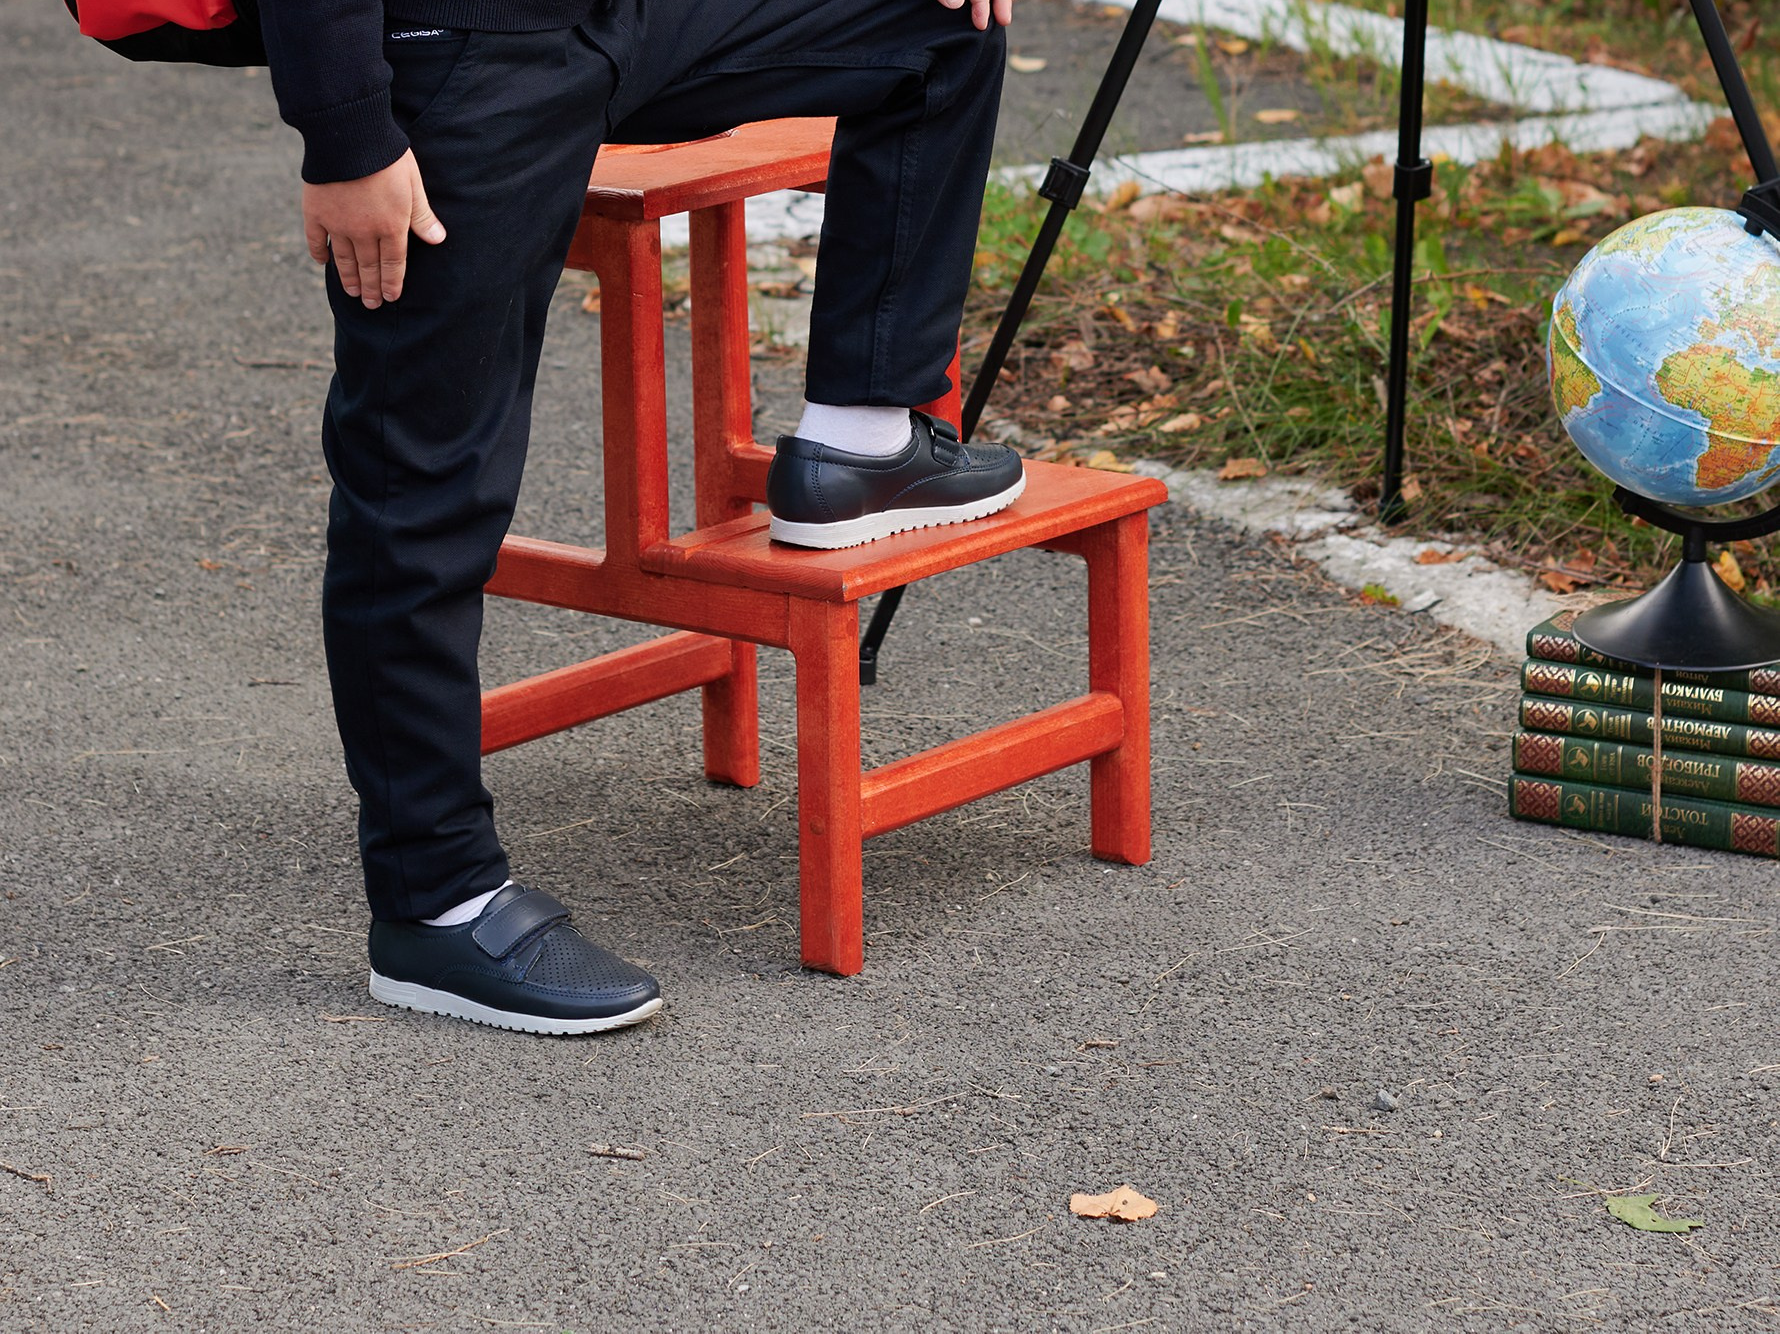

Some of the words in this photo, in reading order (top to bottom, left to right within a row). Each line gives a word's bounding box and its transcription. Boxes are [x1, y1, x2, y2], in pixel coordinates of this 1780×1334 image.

[1675, 670, 1709, 684] Антон
[1666, 698, 1713, 715] Михаил
[1664, 734, 1711, 750] Михаил
[1646, 773, 1710, 793] Алексанр
[1663, 824, 1685, 839] Лев
